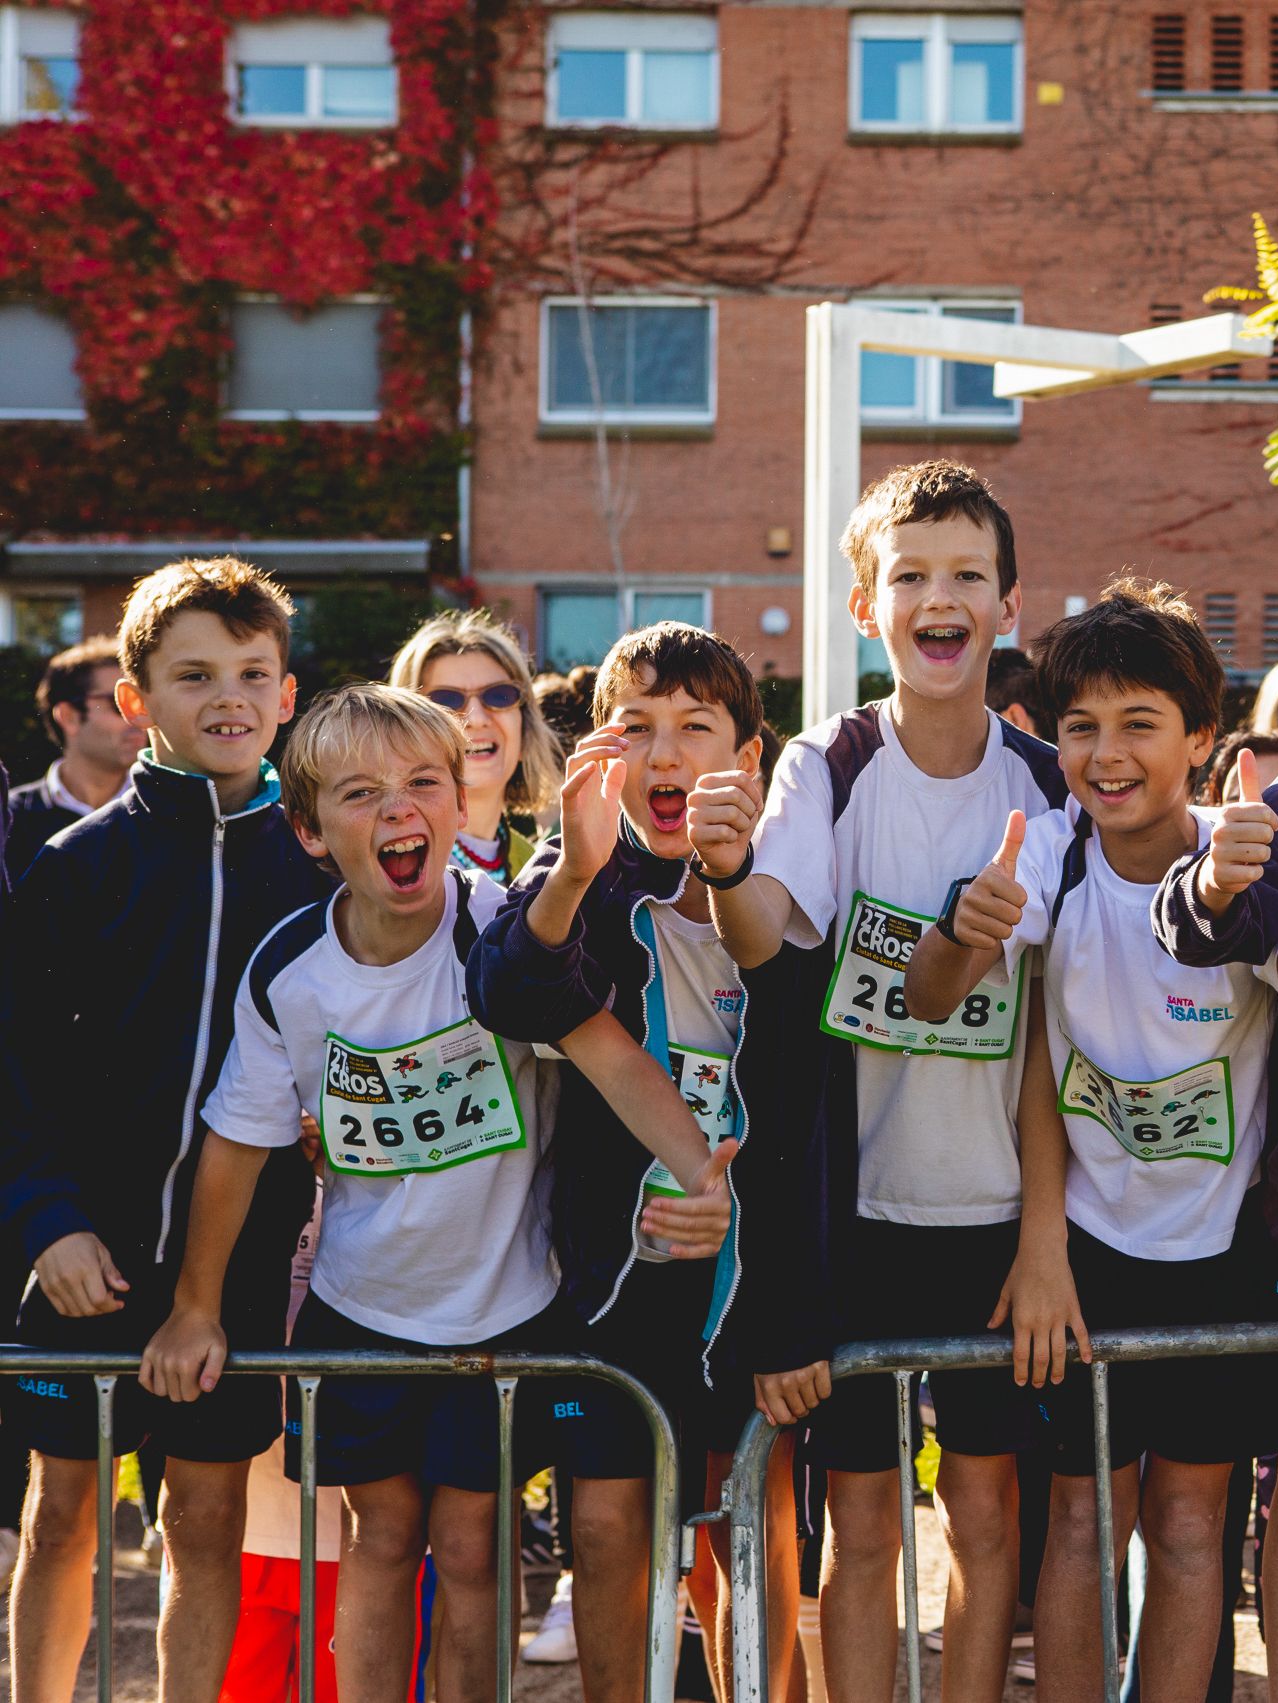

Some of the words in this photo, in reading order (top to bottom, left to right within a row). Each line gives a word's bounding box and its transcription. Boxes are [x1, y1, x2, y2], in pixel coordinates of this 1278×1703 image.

[856, 947, 872, 957] Ciutat
[880, 956, 893, 966] Sant
[858, 928, 916, 963] CROS
[851, 974, 991, 1027] 268
[1167, 995, 1194, 1007] SANTA
[1166, 1003, 1234, 1022] ISABEL
[329, 1067, 384, 1095] CROS
[340, 1094, 485, 1147] 2664
[554, 1401, 585, 1418] BEL
